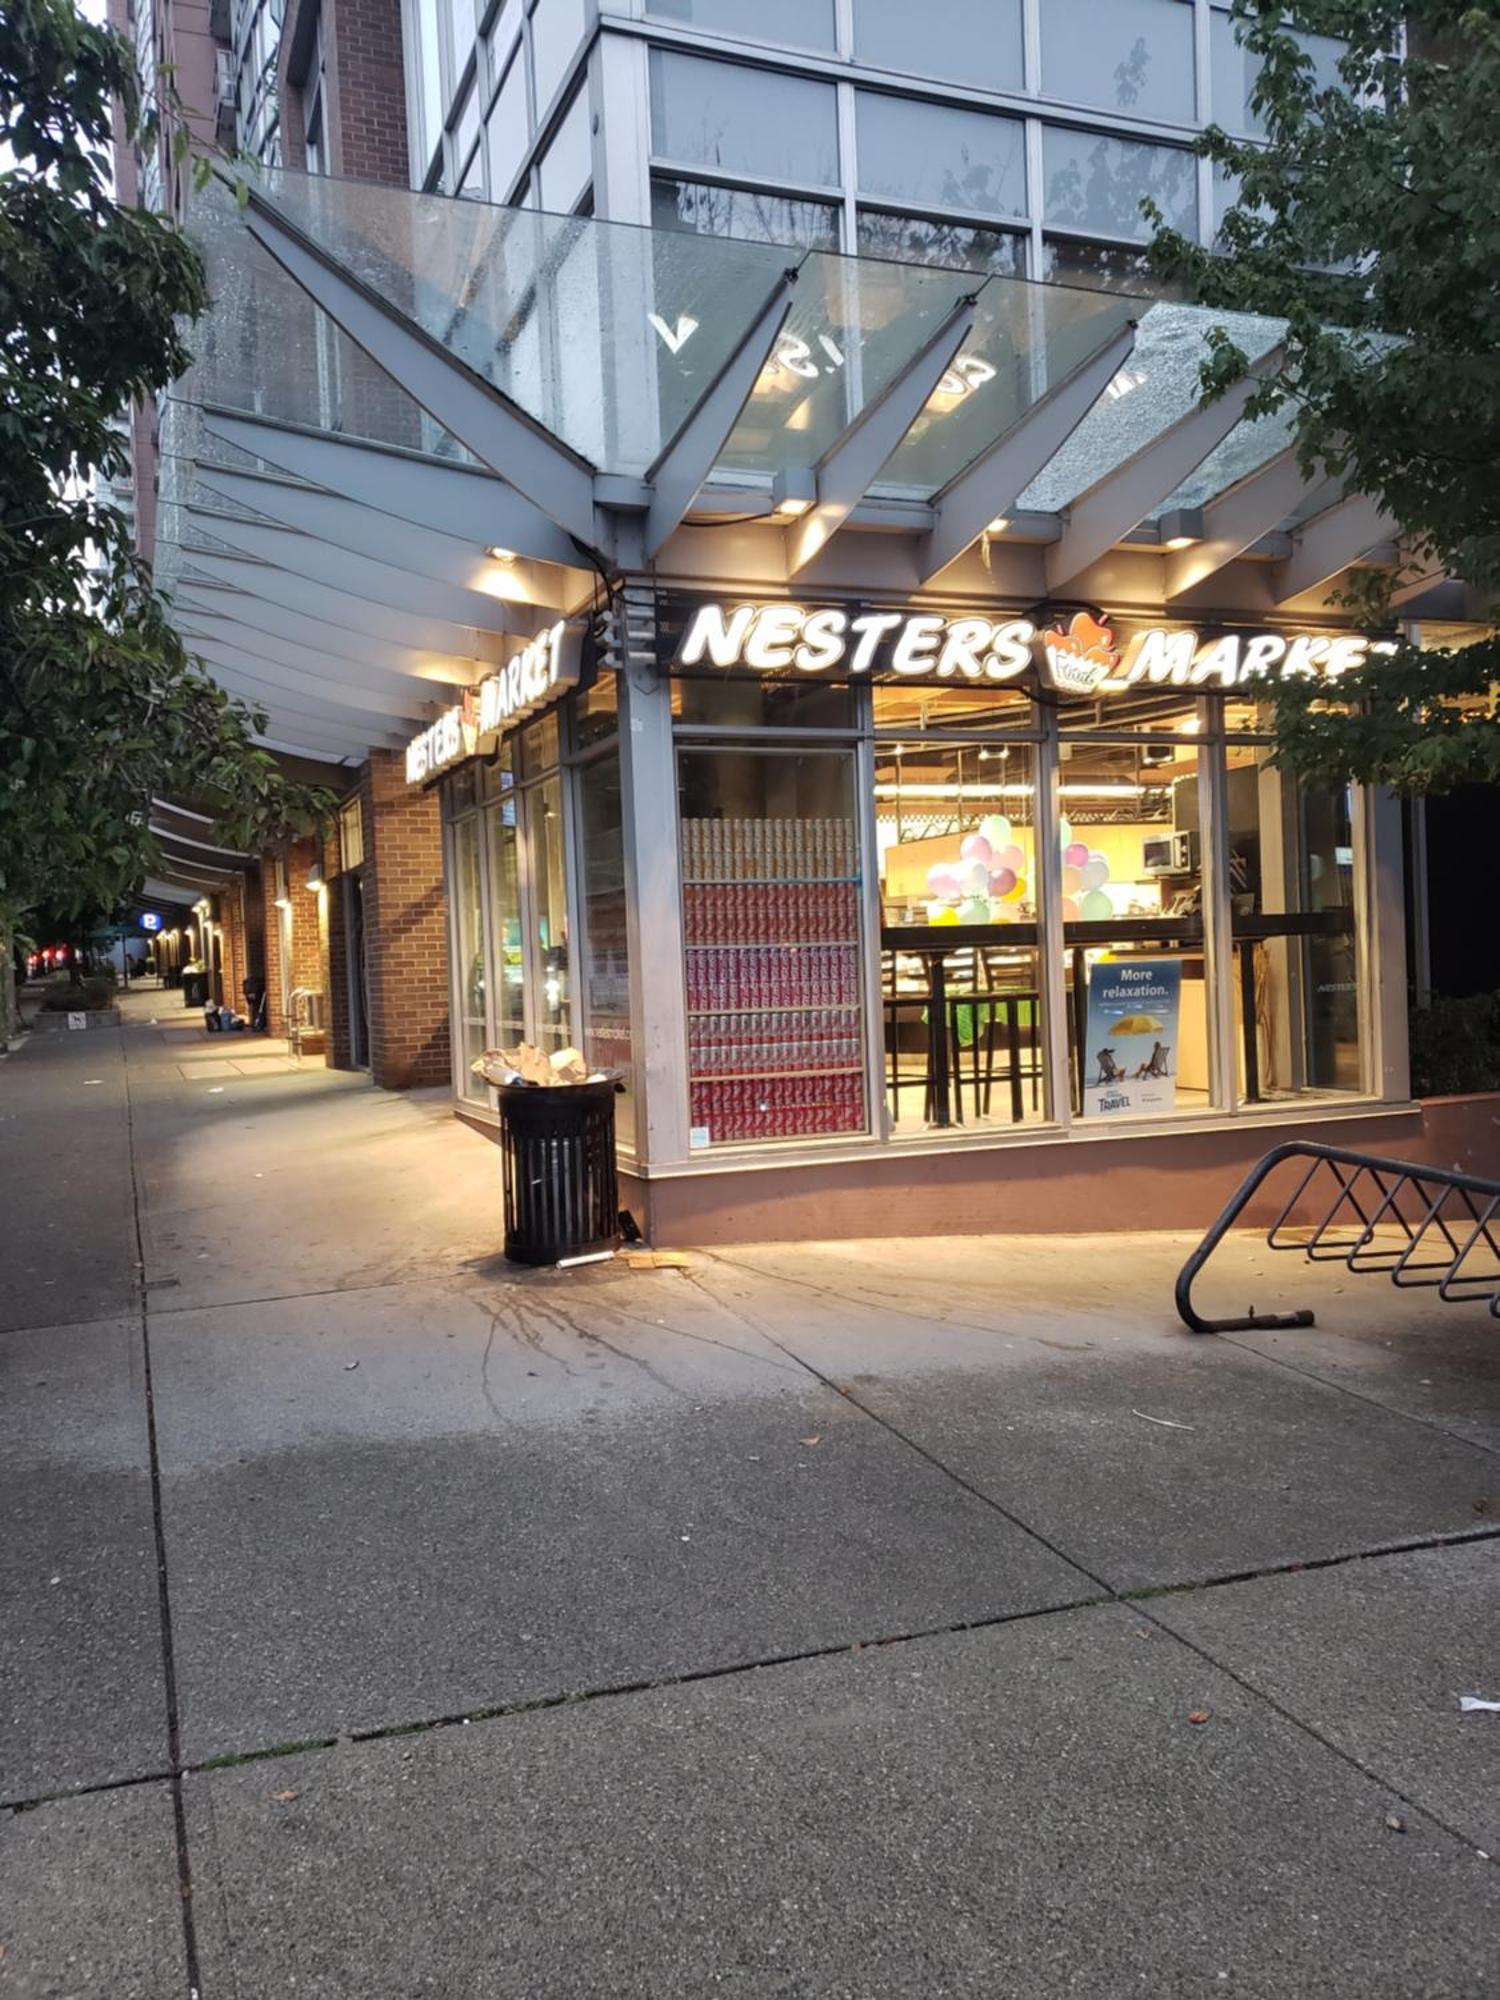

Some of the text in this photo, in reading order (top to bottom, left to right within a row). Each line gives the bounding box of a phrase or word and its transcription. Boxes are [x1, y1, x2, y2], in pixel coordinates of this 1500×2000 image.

[681, 605, 1036, 679] NESTERS
[480, 620, 566, 736] MARKET
[1103, 985, 1168, 998] relaxation.
[1120, 969, 1152, 981] More
